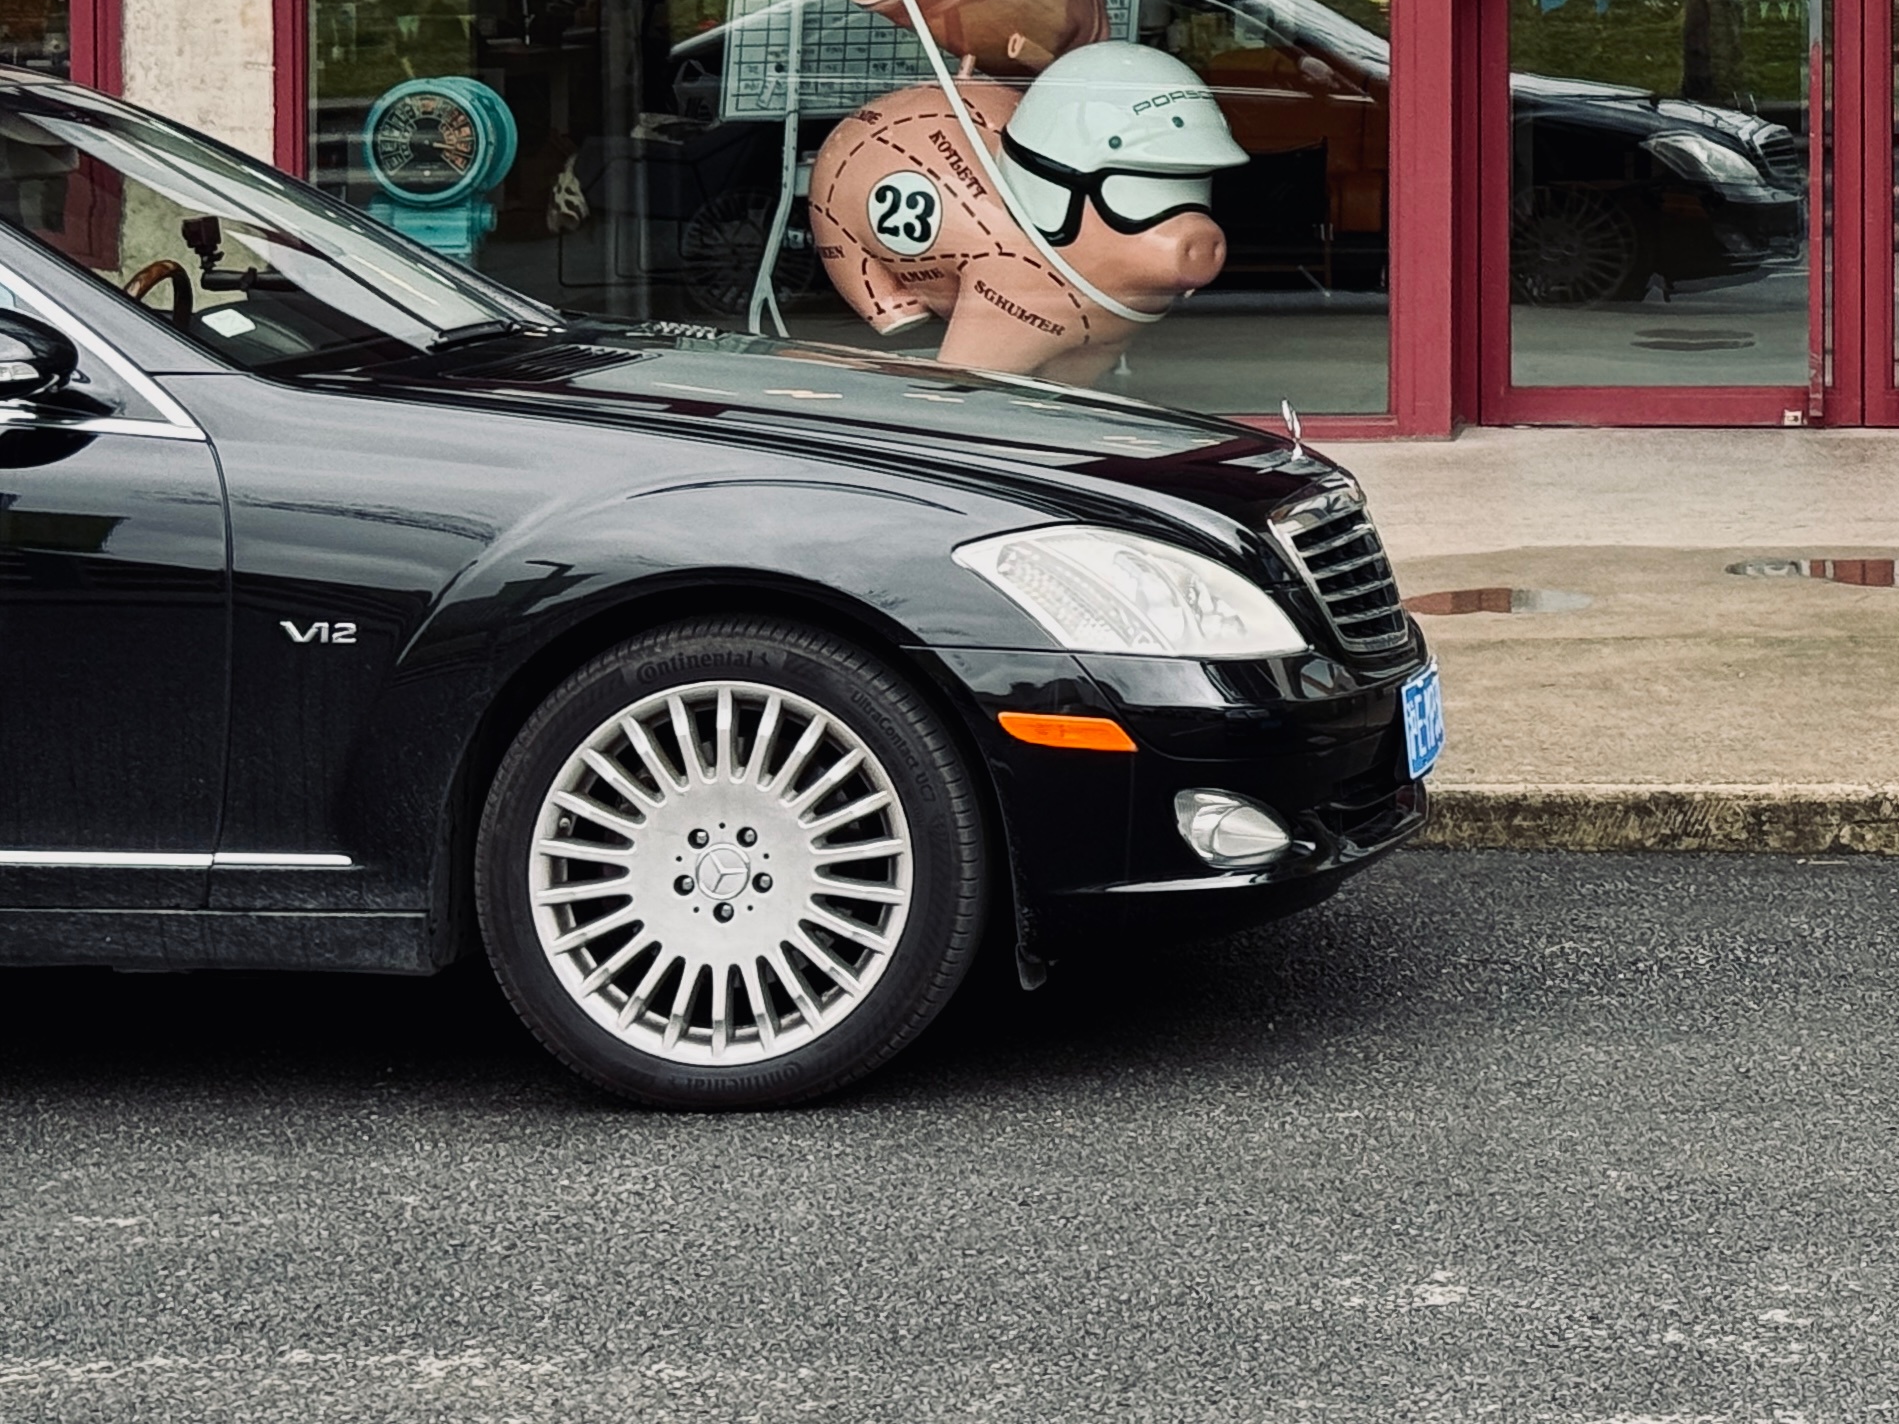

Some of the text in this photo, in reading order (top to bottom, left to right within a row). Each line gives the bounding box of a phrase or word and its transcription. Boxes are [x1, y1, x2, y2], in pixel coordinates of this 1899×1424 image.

[1132, 90, 1214, 116] PORSC
[874, 184, 936, 243] 23
[279, 620, 358, 644] V12
[636, 649, 754, 685] Continental
